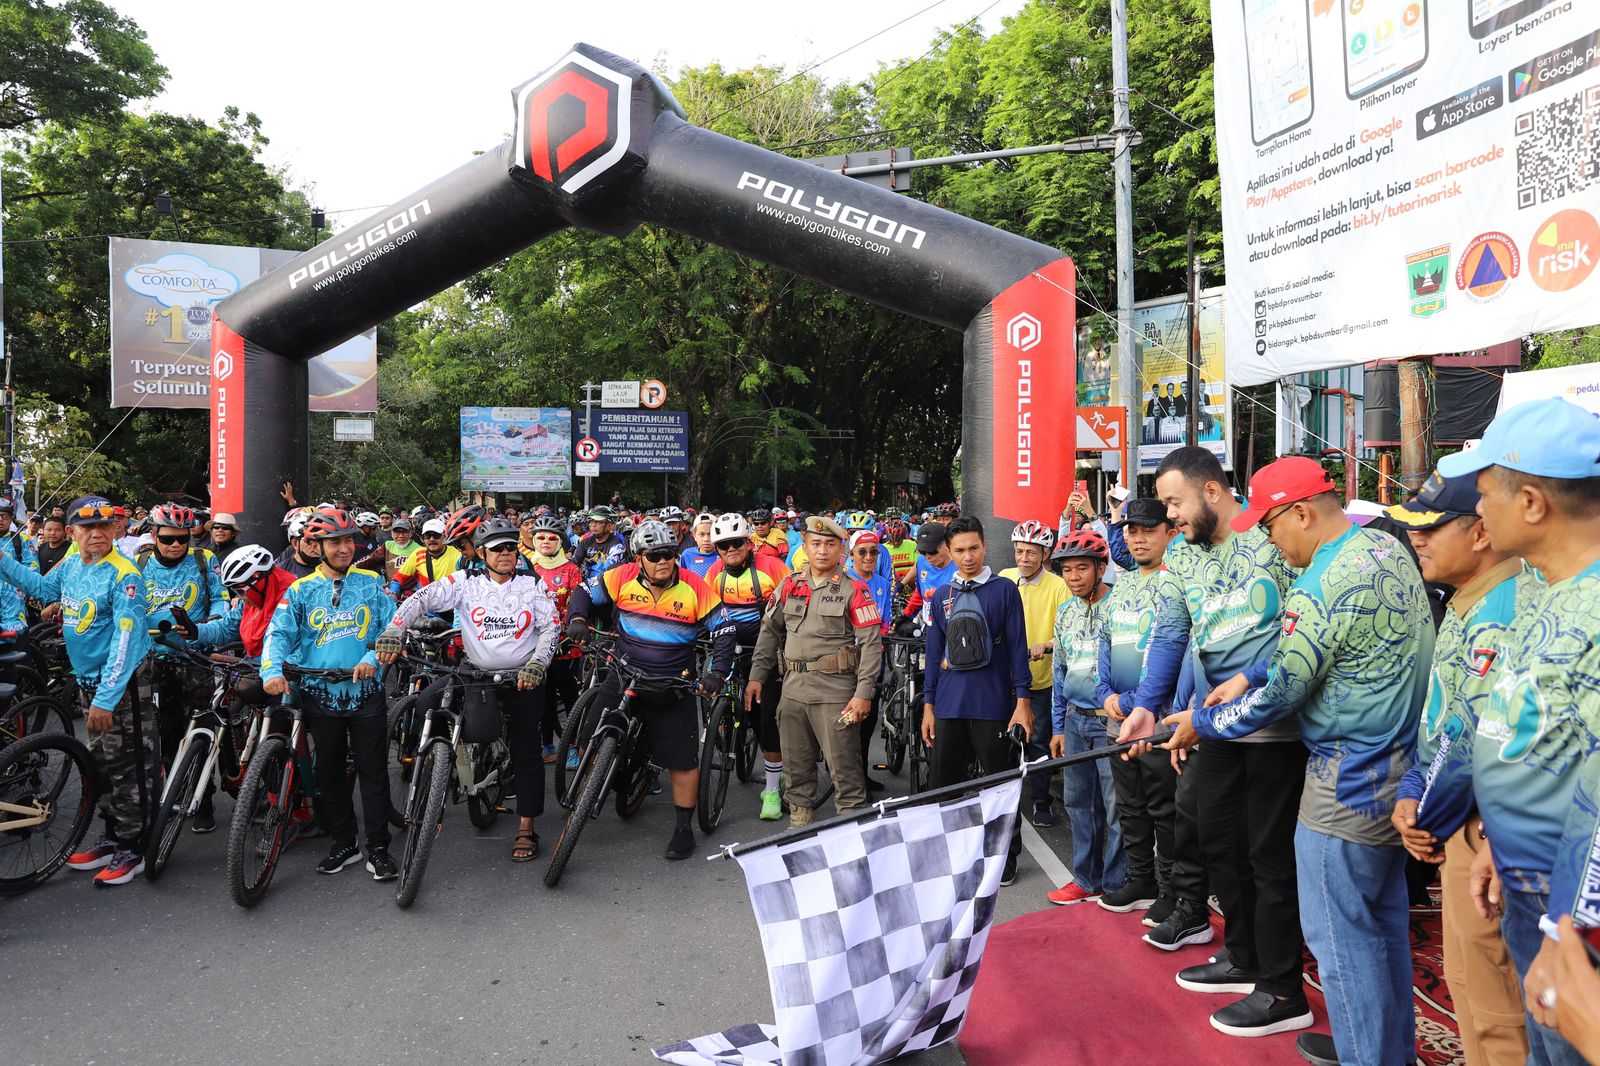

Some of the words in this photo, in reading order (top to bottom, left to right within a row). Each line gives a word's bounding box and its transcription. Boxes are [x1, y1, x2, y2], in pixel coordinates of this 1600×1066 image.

[1478, 30, 1513, 54] Layer
[1515, 1, 1573, 36] bencana
[1537, 56, 1552, 68] GET
[1553, 53, 1560, 62] IT
[1561, 48, 1574, 58] ON
[1538, 55, 1584, 82] Google
[1359, 90, 1390, 111] Pilihan
[1392, 77, 1418, 95] layer
[1441, 95, 1469, 111] Available
[1479, 86, 1491, 95] the
[1441, 106, 1464, 126] App
[1465, 95, 1496, 116] Store
[1246, 170, 1280, 193] Aplikasi
[1281, 162, 1293, 177] ini
[1295, 151, 1321, 171] udah
[1322, 143, 1344, 160] ada
[1345, 135, 1356, 149] di
[1360, 116, 1403, 144] Google
[1256, 138, 1288, 159] Tampilan
[1288, 128, 1312, 144] Home
[1246, 176, 1317, 209] Play/Appstore,
[1318, 147, 1373, 181] download
[1375, 138, 1394, 162] ya!
[736, 171, 927, 250] POLYGON
[1247, 226, 1275, 246] Untuk
[1276, 210, 1321, 236] informasi
[1322, 200, 1348, 221] lebih
[1349, 189, 1384, 214] lanjut,
[1386, 181, 1412, 198] bisa
[1414, 169, 1443, 188] scan
[1445, 144, 1505, 177] barcode
[756, 202, 890, 256] www.polygonbikes.com
[1249, 241, 1270, 263] atau
[1271, 228, 1319, 257] download
[1320, 222, 1352, 243] pada:
[1353, 180, 1462, 229] bit.ly/tutorinarisk
[288, 198, 432, 290] POLYGON
[1538, 239, 1591, 277] risk
[312, 229, 418, 292] www.polygonbikes.com
[141, 274, 216, 289] COMFORTA
[1267, 283, 1285, 296] kami
[1292, 275, 1311, 289] sosial
[1311, 270, 1336, 284] media:
[1268, 313, 1317, 331] pkbpbdsumbar
[133, 379, 208, 396] Seluruh
[601, 413, 675, 424] PEMBERITAHUAN
[1017, 359, 1032, 487] POLYGON
[217, 387, 227, 489] POLYGON
[651, 434, 675, 442] BAYAR
[655, 449, 685, 457] PADANG
[630, 593, 650, 604] FCC
[1249, 578, 1279, 631] 9
[470, 606, 516, 628] Gowes
[664, 611, 690, 621] TREK
